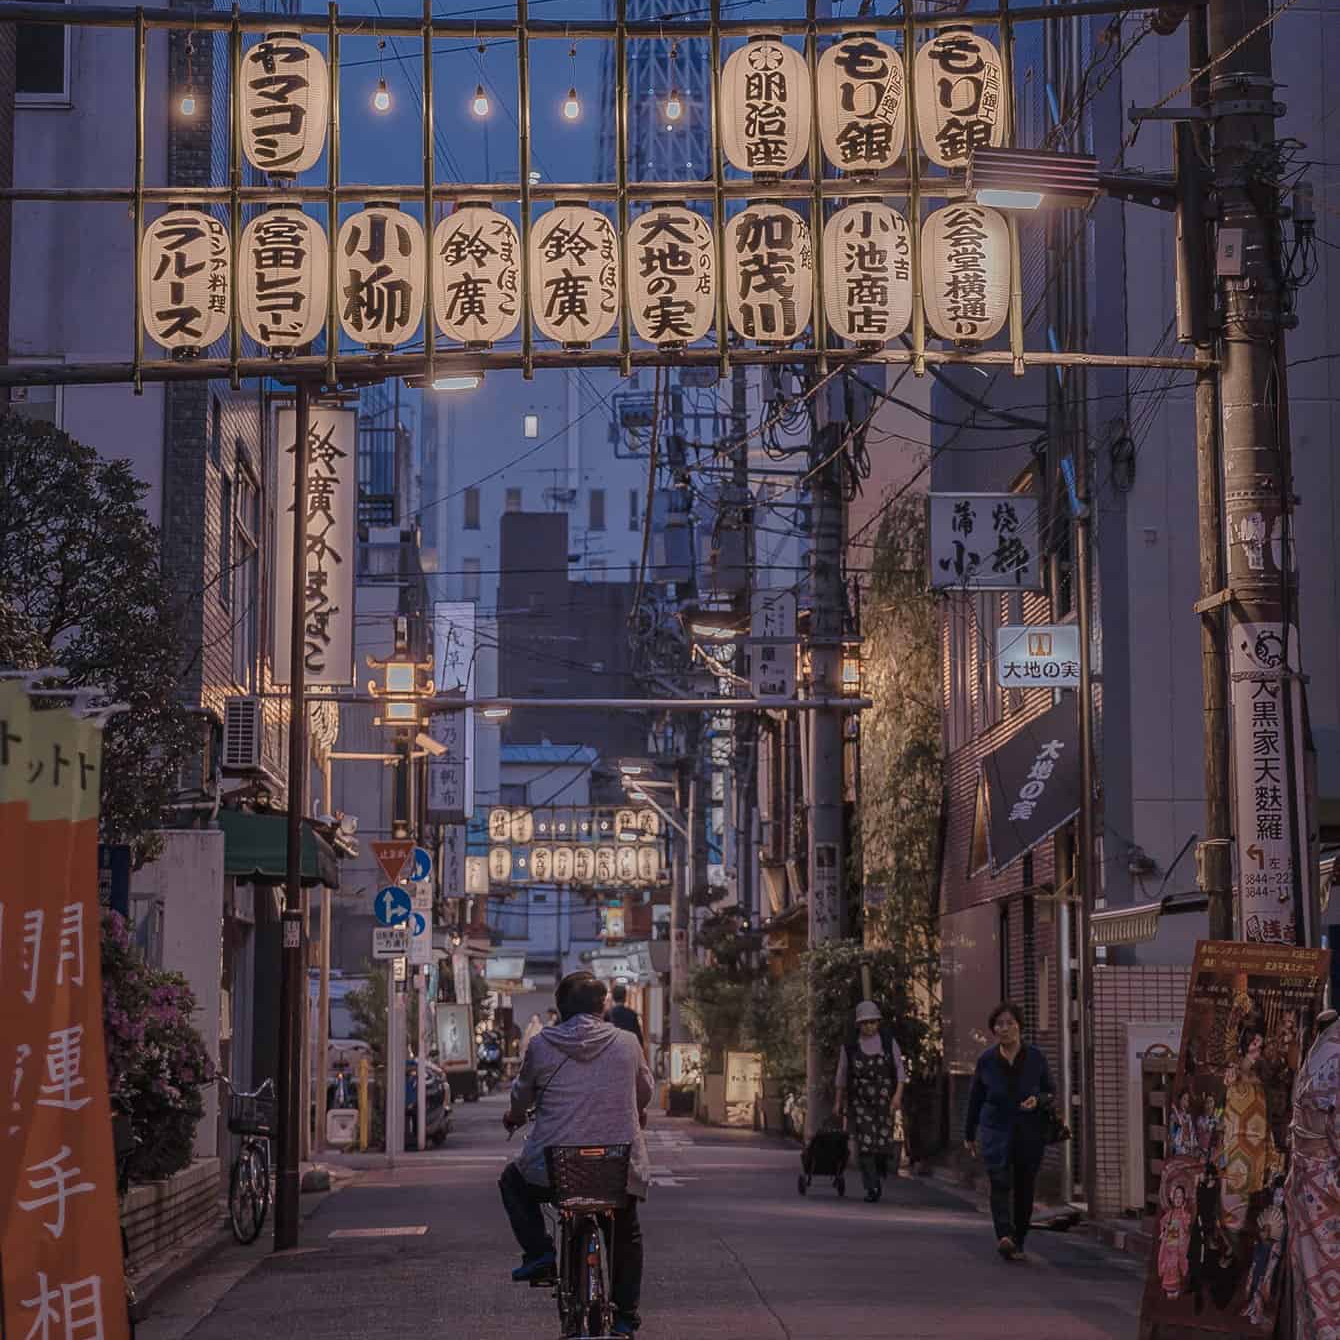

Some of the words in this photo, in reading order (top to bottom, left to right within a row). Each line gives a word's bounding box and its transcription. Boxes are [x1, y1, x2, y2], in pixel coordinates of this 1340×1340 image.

[248, 43, 310, 168] ヤマコシ
[834, 42, 893, 163] もり銀
[928, 37, 993, 162] もり銀
[152, 218, 206, 339] ラルース
[204, 219, 228, 315] ロシア料理
[252, 216, 308, 342] 宮田レコード
[343, 213, 413, 333] 小柳
[439, 222, 499, 326] 鈴廣
[491, 219, 519, 316] かまぼこ
[538, 218, 598, 327] 鈴廣
[593, 217, 617, 314] かまぼこ
[638, 213, 696, 339] 大地の実
[735, 212, 797, 338] 加茂川
[844, 210, 889, 335] 小池商店
[942, 208, 990, 336] 公会堂横通り
[1003, 660, 1081, 679] 大地の実
[1008, 740, 1065, 820] 大地の実
[1250, 673, 1283, 841] 大黒家天麩羅
[1245, 872, 1290, 885] 3844-22
